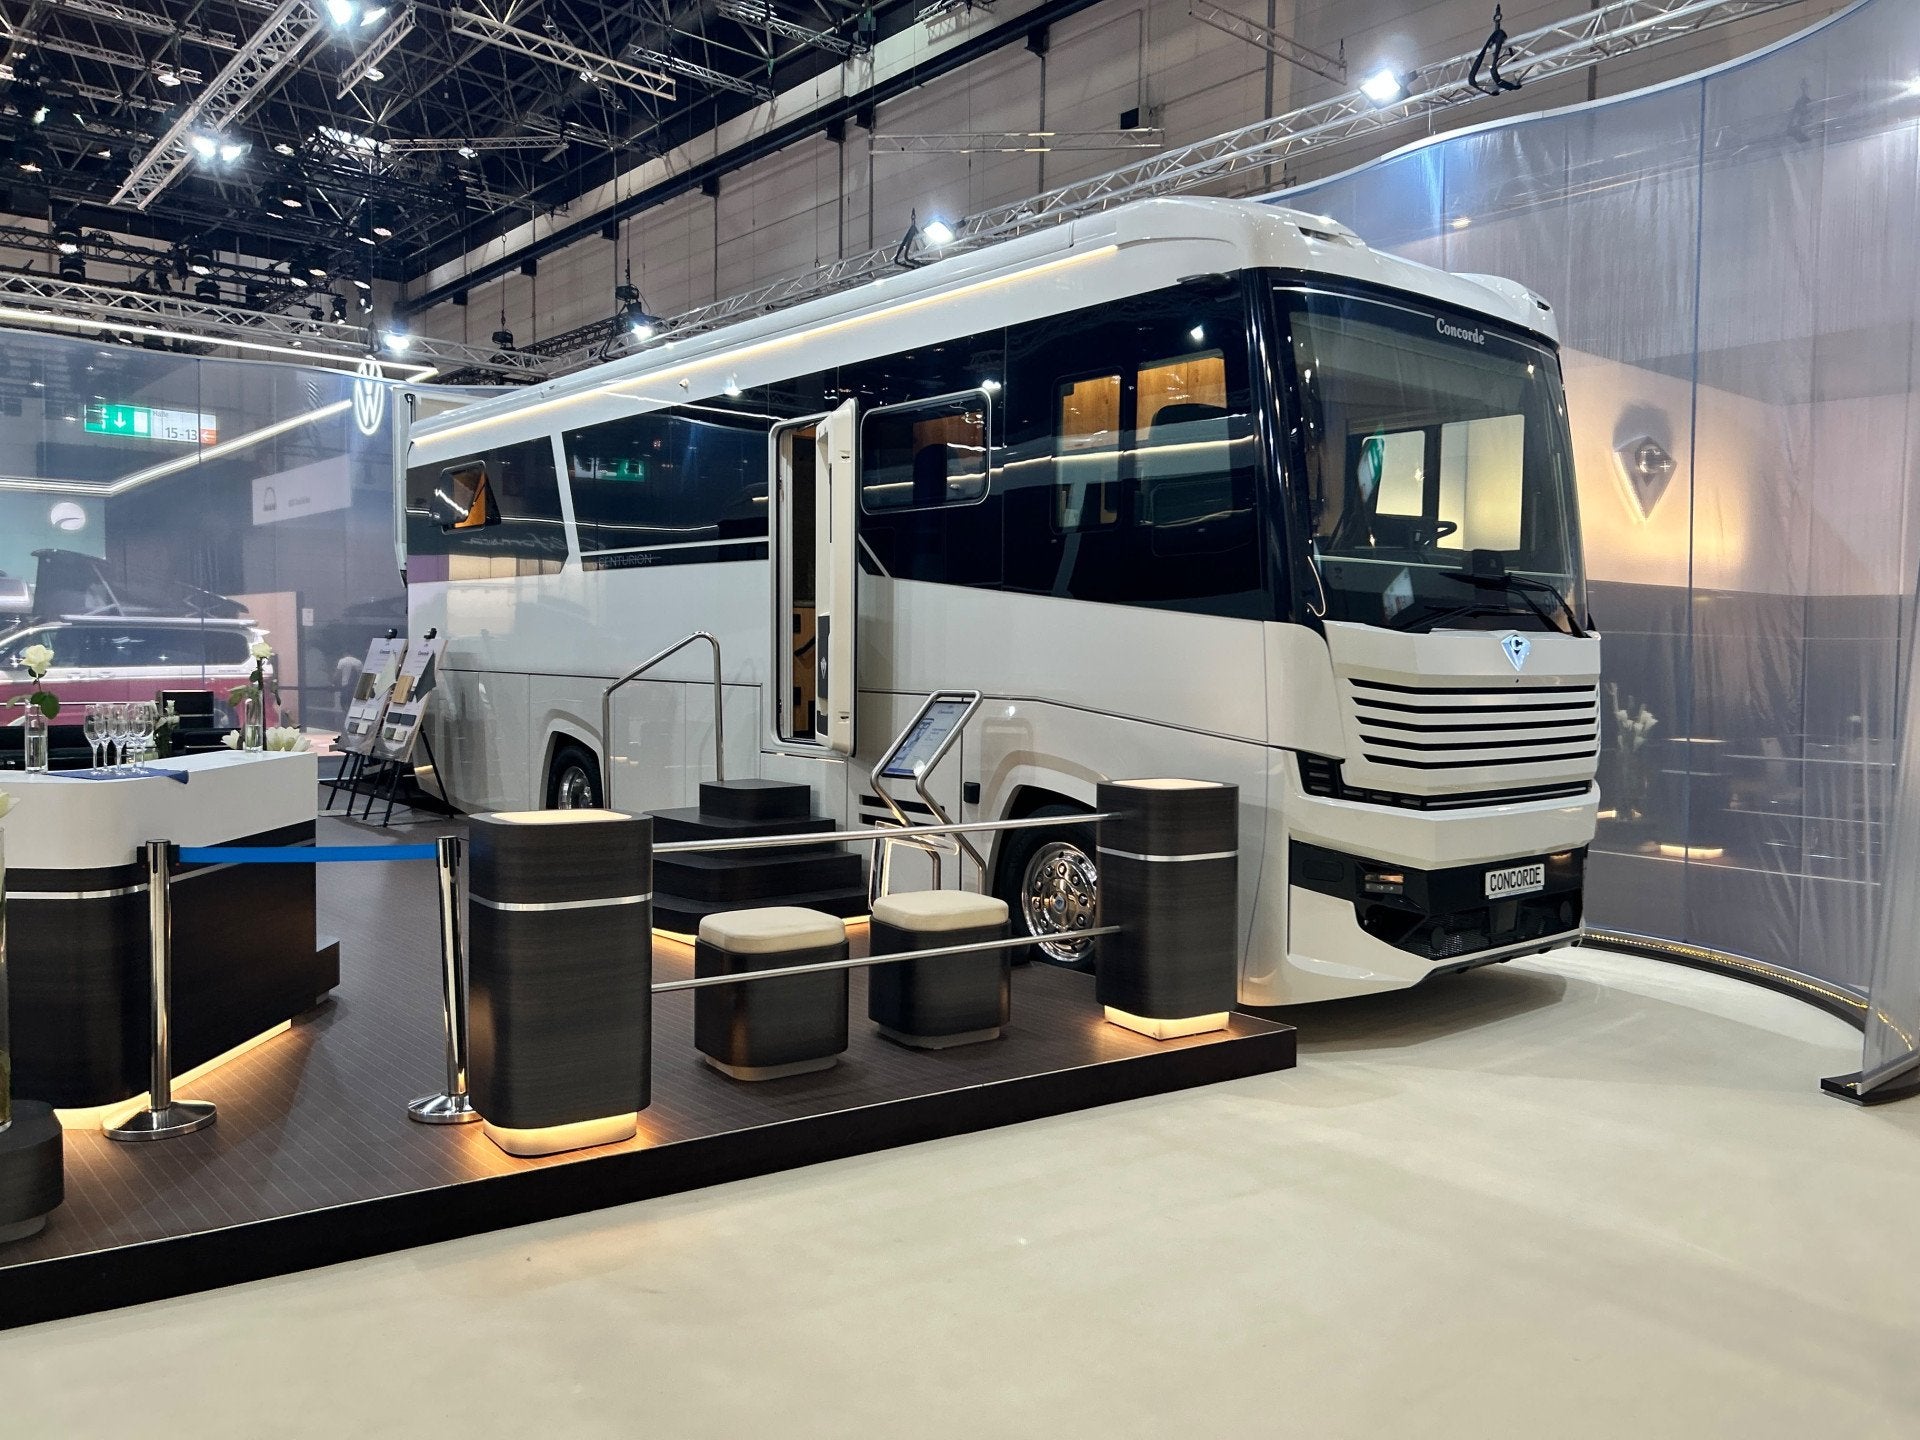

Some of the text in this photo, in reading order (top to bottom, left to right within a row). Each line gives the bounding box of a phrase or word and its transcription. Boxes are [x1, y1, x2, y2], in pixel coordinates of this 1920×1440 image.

[1436, 317, 1485, 345] Concorde
[599, 553, 653, 568] CENTURION
[1490, 866, 1542, 892] CONCORDE
